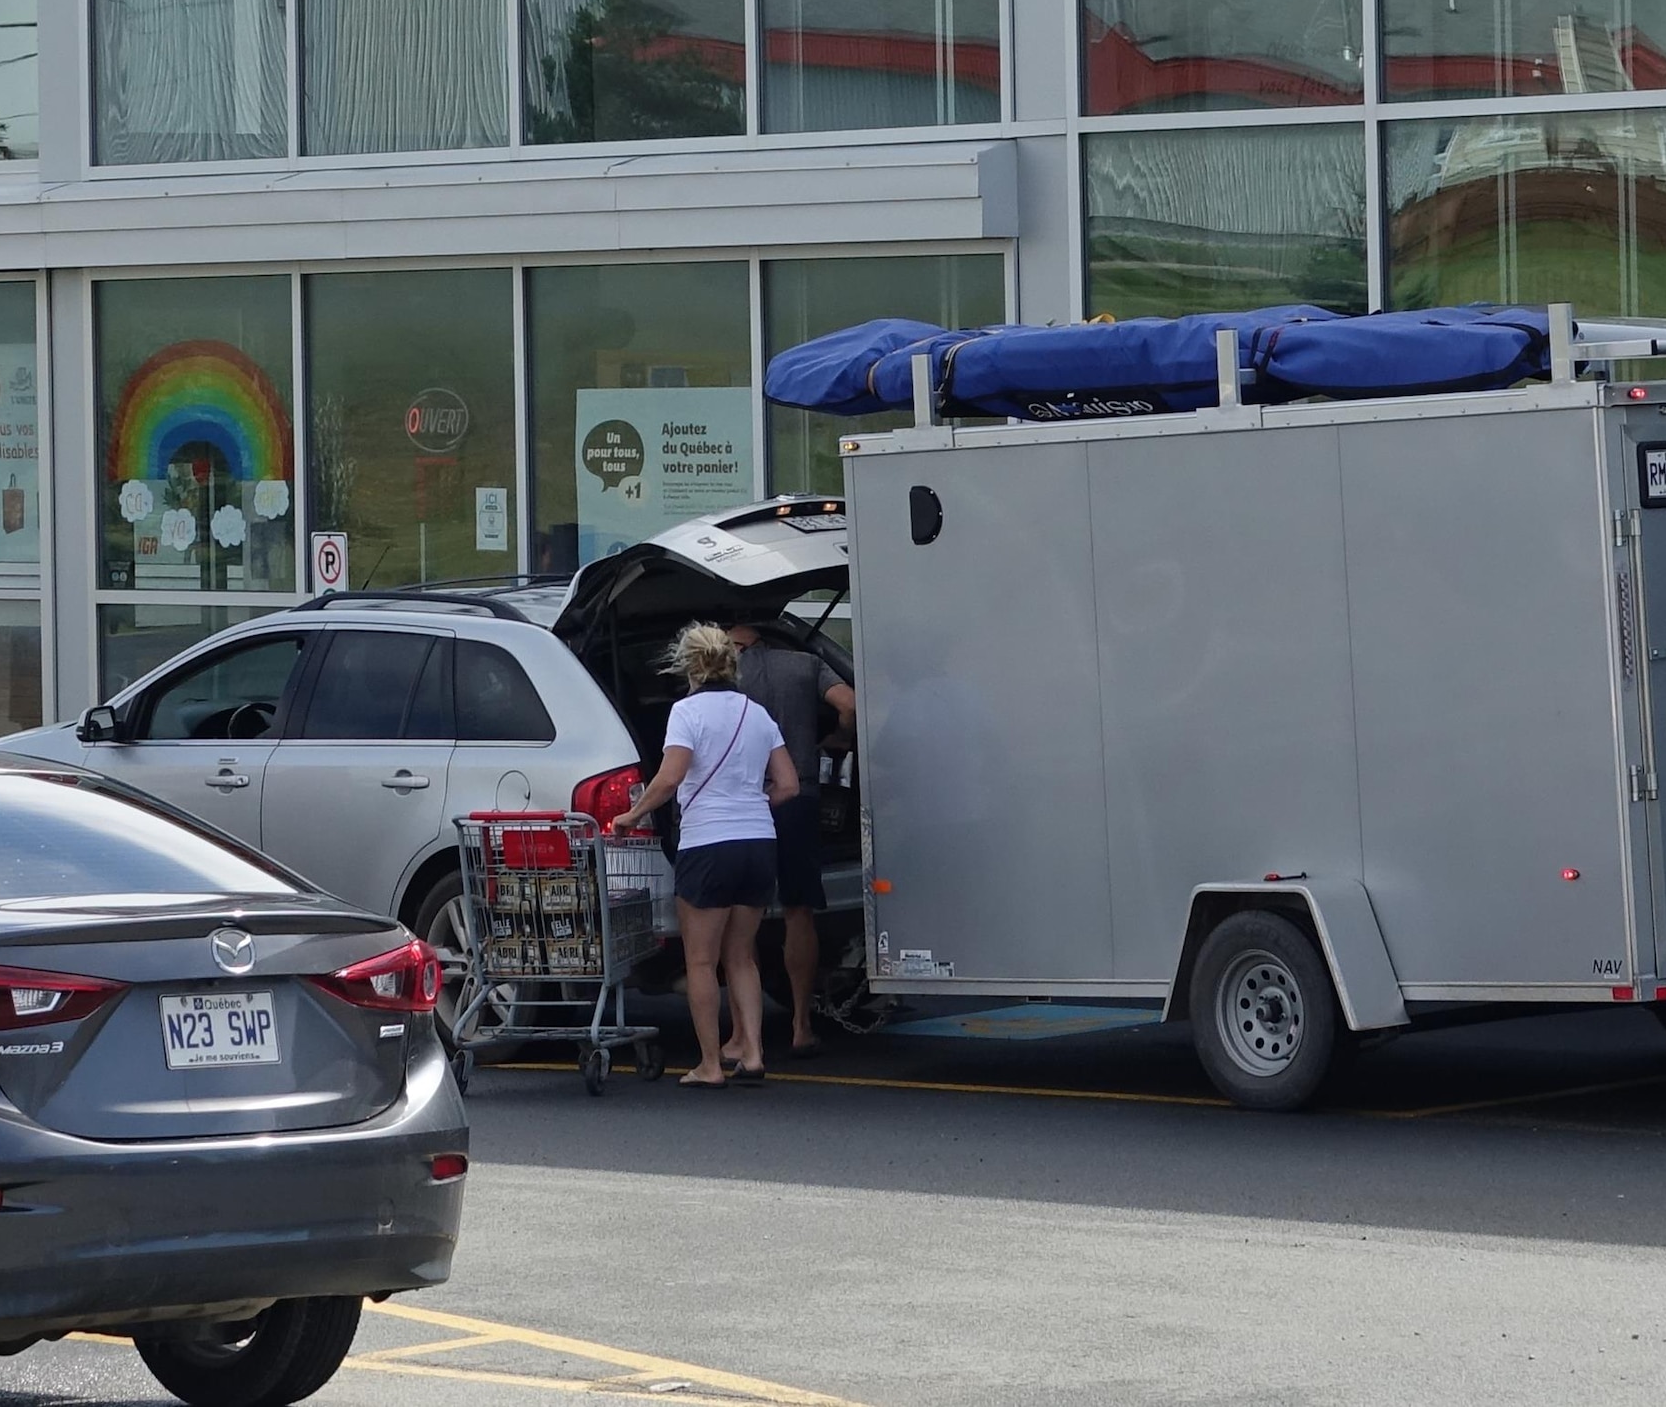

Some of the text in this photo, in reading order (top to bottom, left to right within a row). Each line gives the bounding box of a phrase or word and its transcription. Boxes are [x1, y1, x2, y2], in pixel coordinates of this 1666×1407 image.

[408, 407, 465, 434] OUVERT
[15, 423, 35, 436] vos
[661, 422, 707, 438] Ajoutez
[606, 432, 621, 443] Un
[586, 446, 640, 461] pour tous,
[662, 441, 733, 457] du Québec à
[602, 461, 626, 472] tous
[663, 462, 694, 474] votre
[625, 481, 642, 500] +1
[138, 536, 158, 556] IGA
[1592, 959, 1623, 974] NAV
[204, 998, 242, 1010] Québec
[167, 1009, 271, 1050] N23 SWP
[206, 1054, 218, 1062] me
[219, 1051, 255, 1061] souviens
